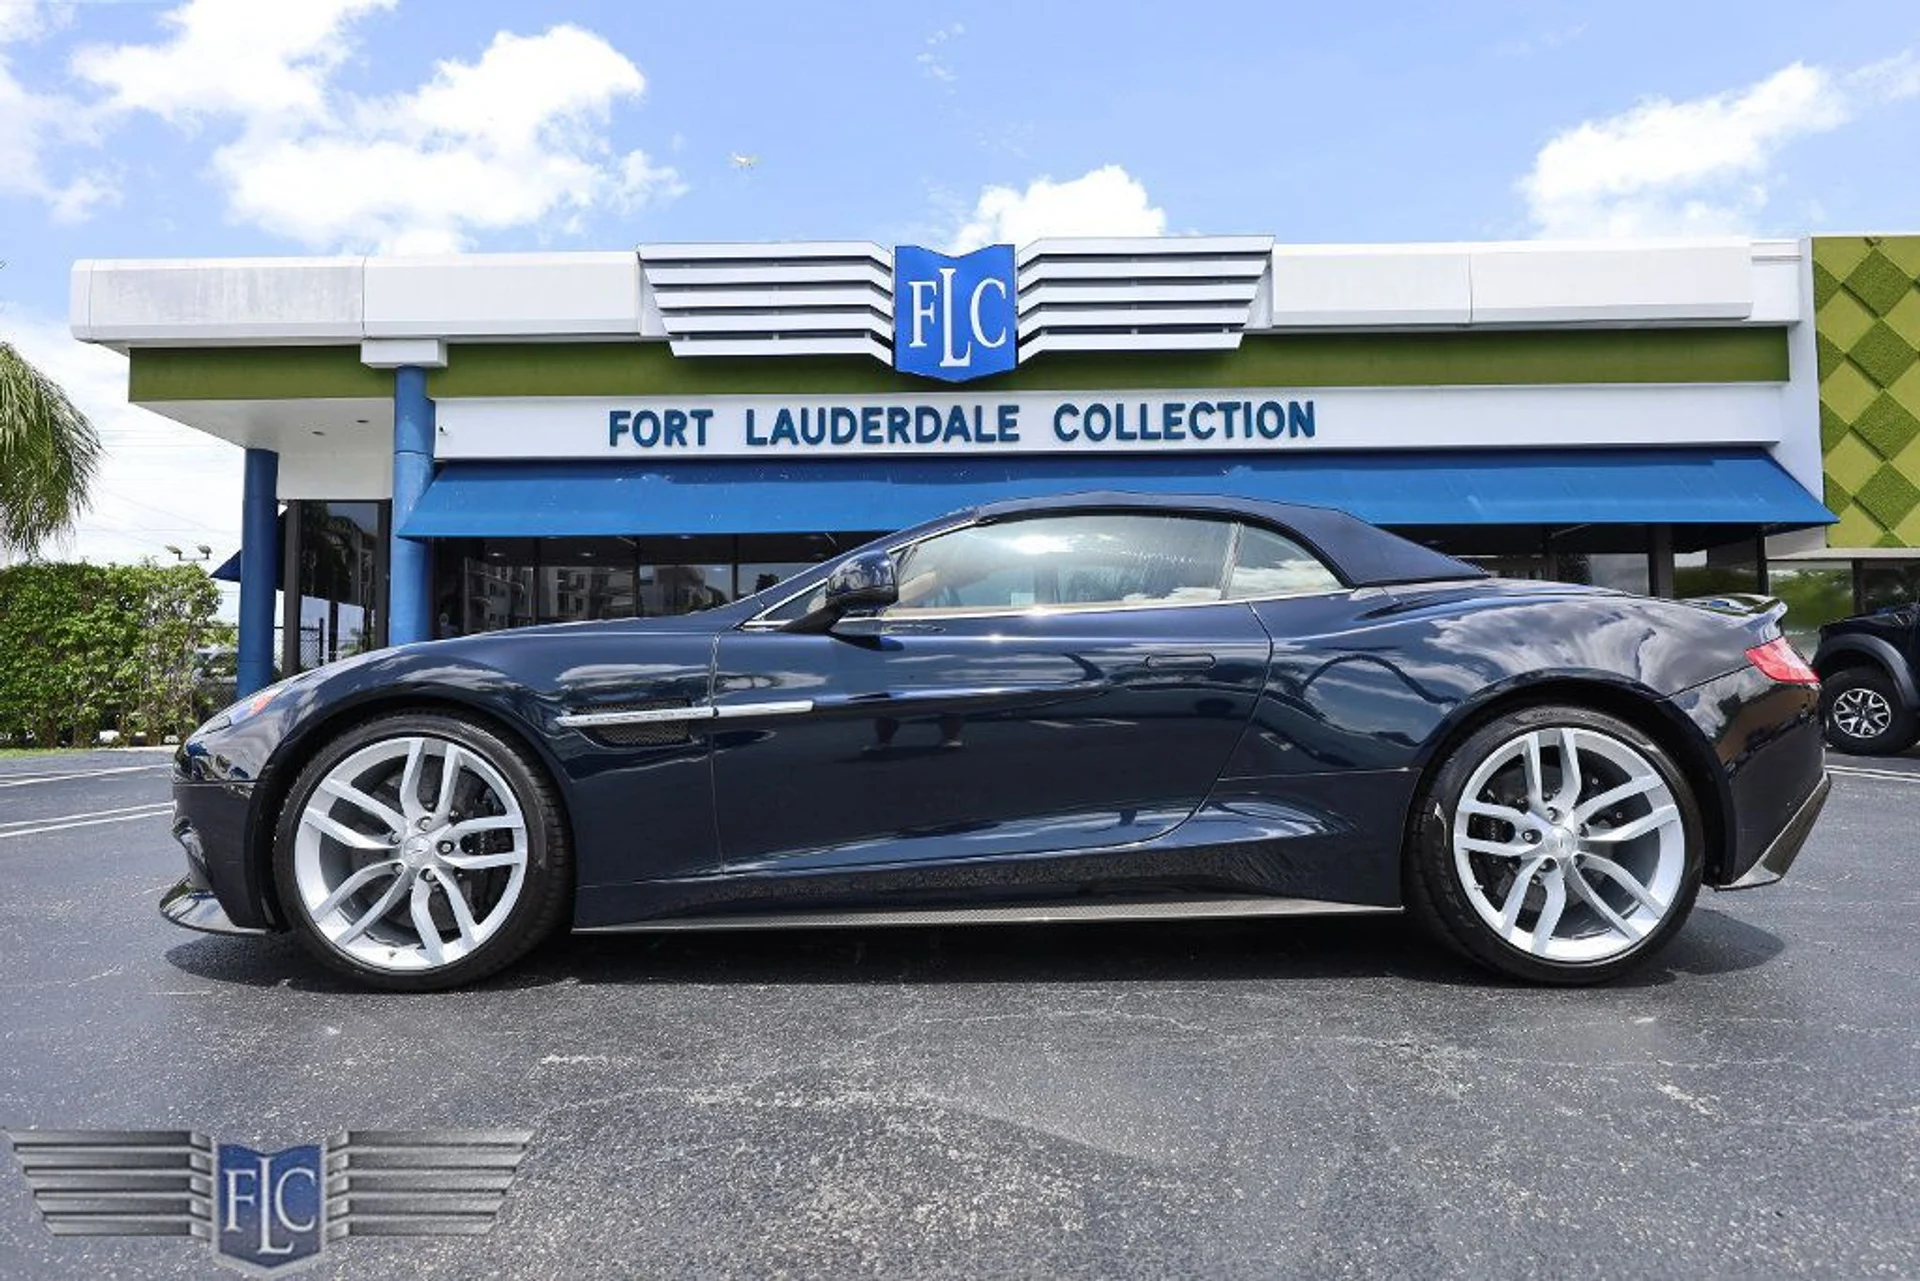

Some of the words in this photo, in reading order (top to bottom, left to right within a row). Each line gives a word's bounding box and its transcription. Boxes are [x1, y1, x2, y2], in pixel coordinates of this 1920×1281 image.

[908, 267, 1007, 367] FLC
[609, 408, 715, 448] FORT
[746, 404, 1021, 447] LAUDERDALE
[1053, 400, 1316, 443] COLLECTION
